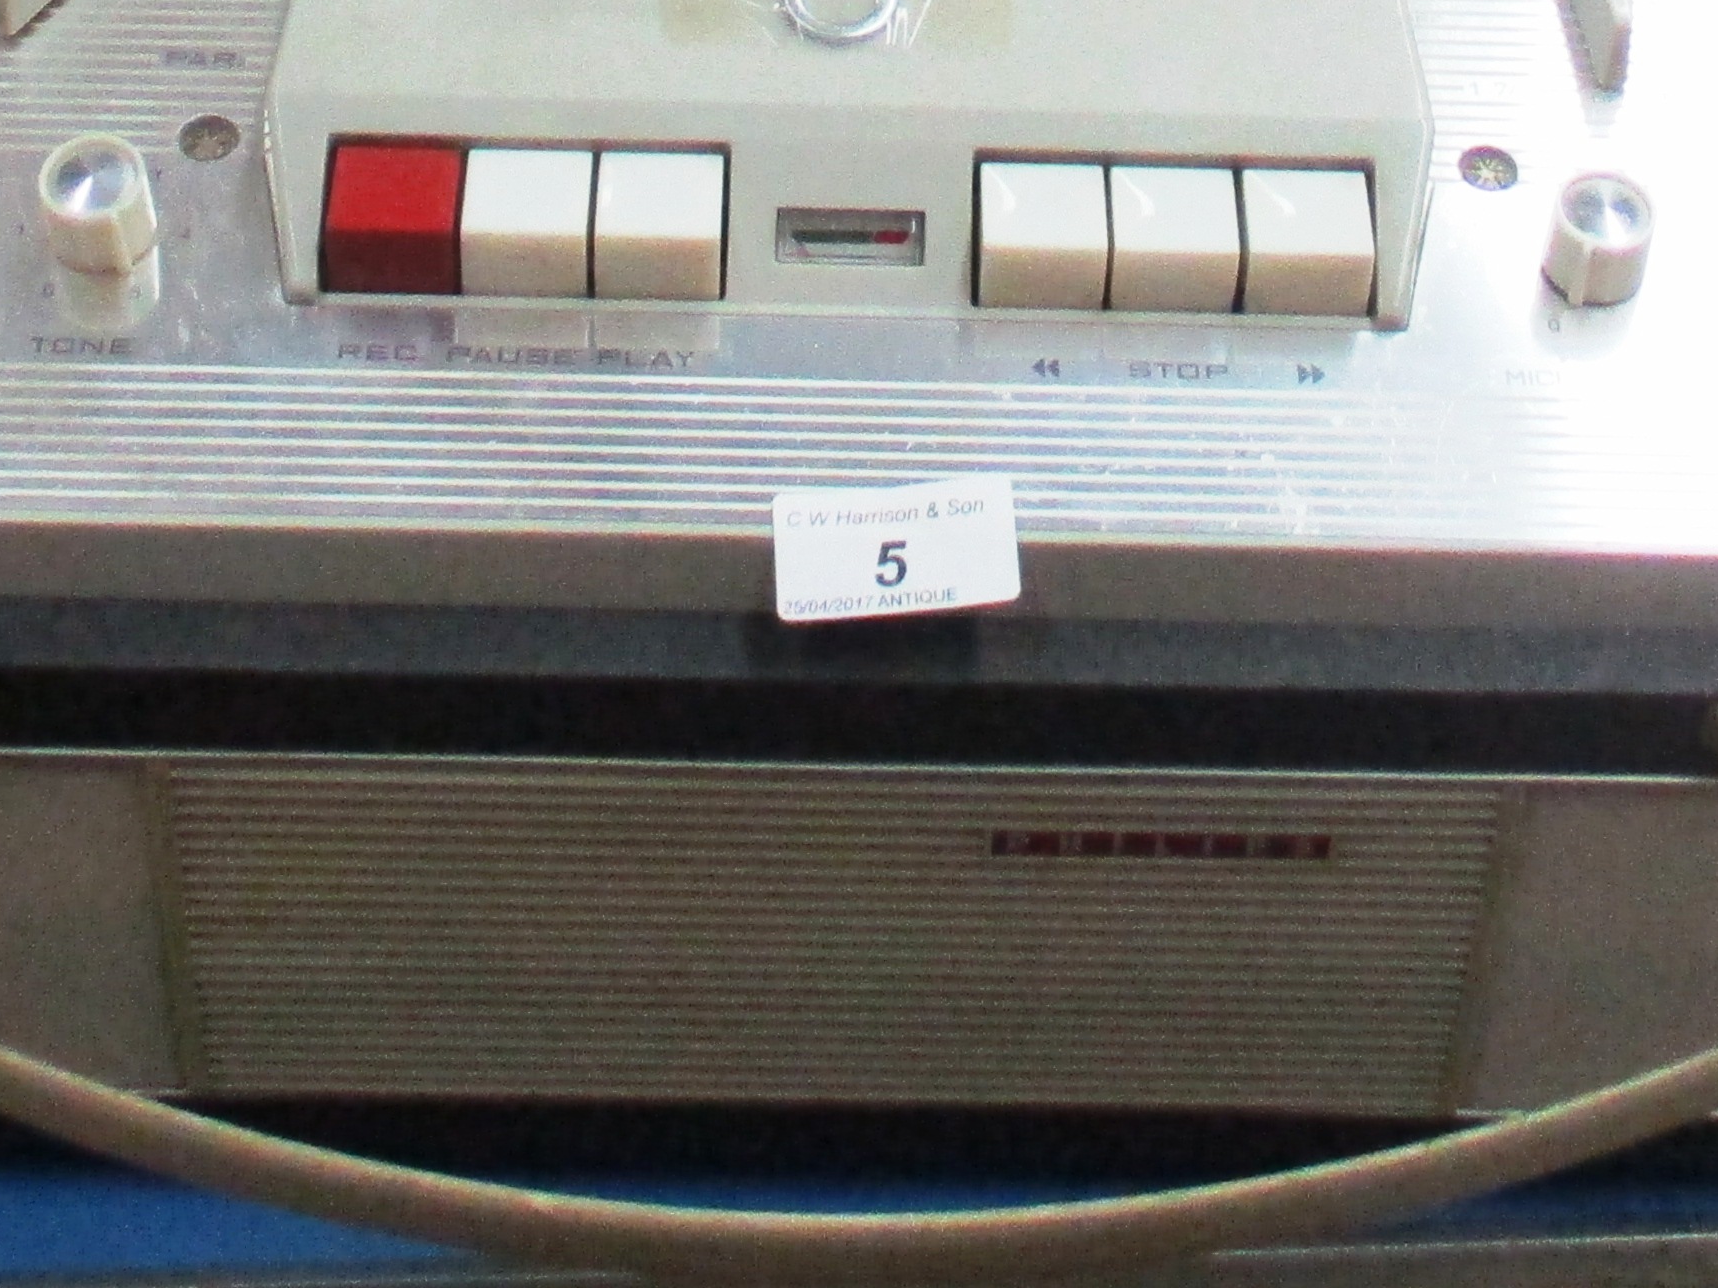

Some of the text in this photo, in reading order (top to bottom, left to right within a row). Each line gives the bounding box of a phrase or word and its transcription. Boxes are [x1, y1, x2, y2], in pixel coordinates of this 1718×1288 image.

[30, 335, 133, 355] TONE
[336, 344, 418, 362] REC
[446, 344, 578, 367] PAUSE
[594, 348, 695, 369] PLAY
[1126, 361, 1229, 380] STOP
[786, 497, 985, 527] C W Harrison & Son
[875, 539, 907, 587] 5
[877, 587, 958, 609] ANTIQUE
